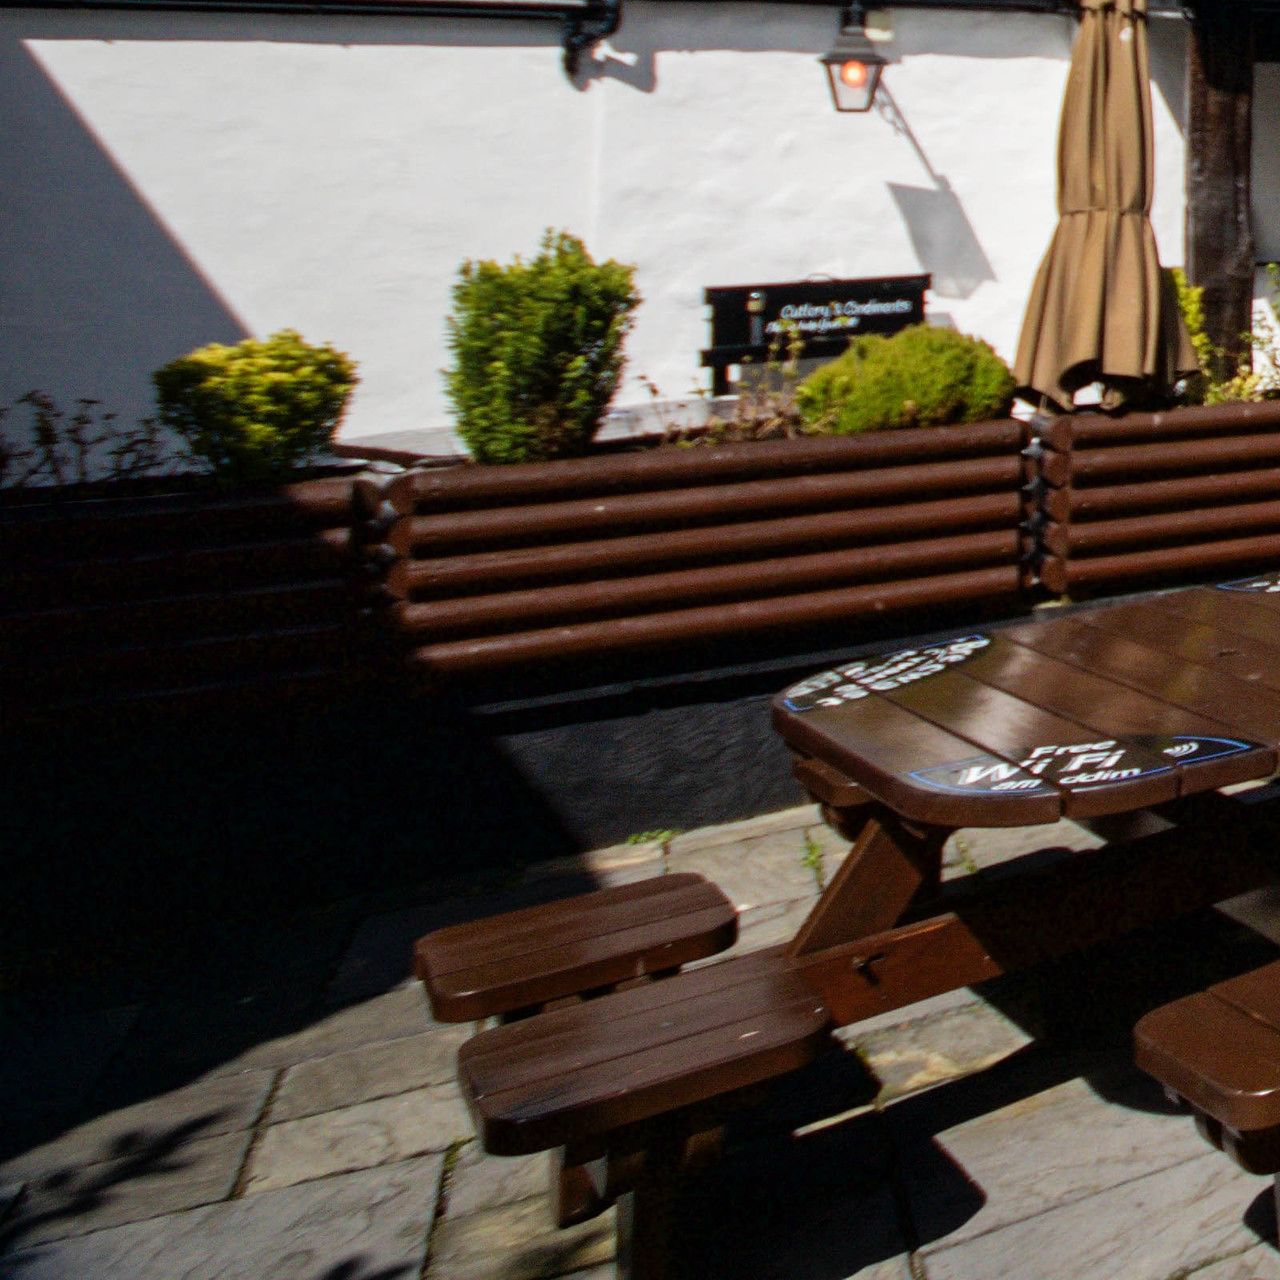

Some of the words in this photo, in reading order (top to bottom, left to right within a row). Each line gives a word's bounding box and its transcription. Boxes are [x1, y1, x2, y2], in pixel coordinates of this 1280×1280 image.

[1029, 739, 1118, 759] Free
[1060, 750, 1128, 773] Fi
[991, 778, 1043, 791] am
[1060, 767, 1142, 785] ddim
